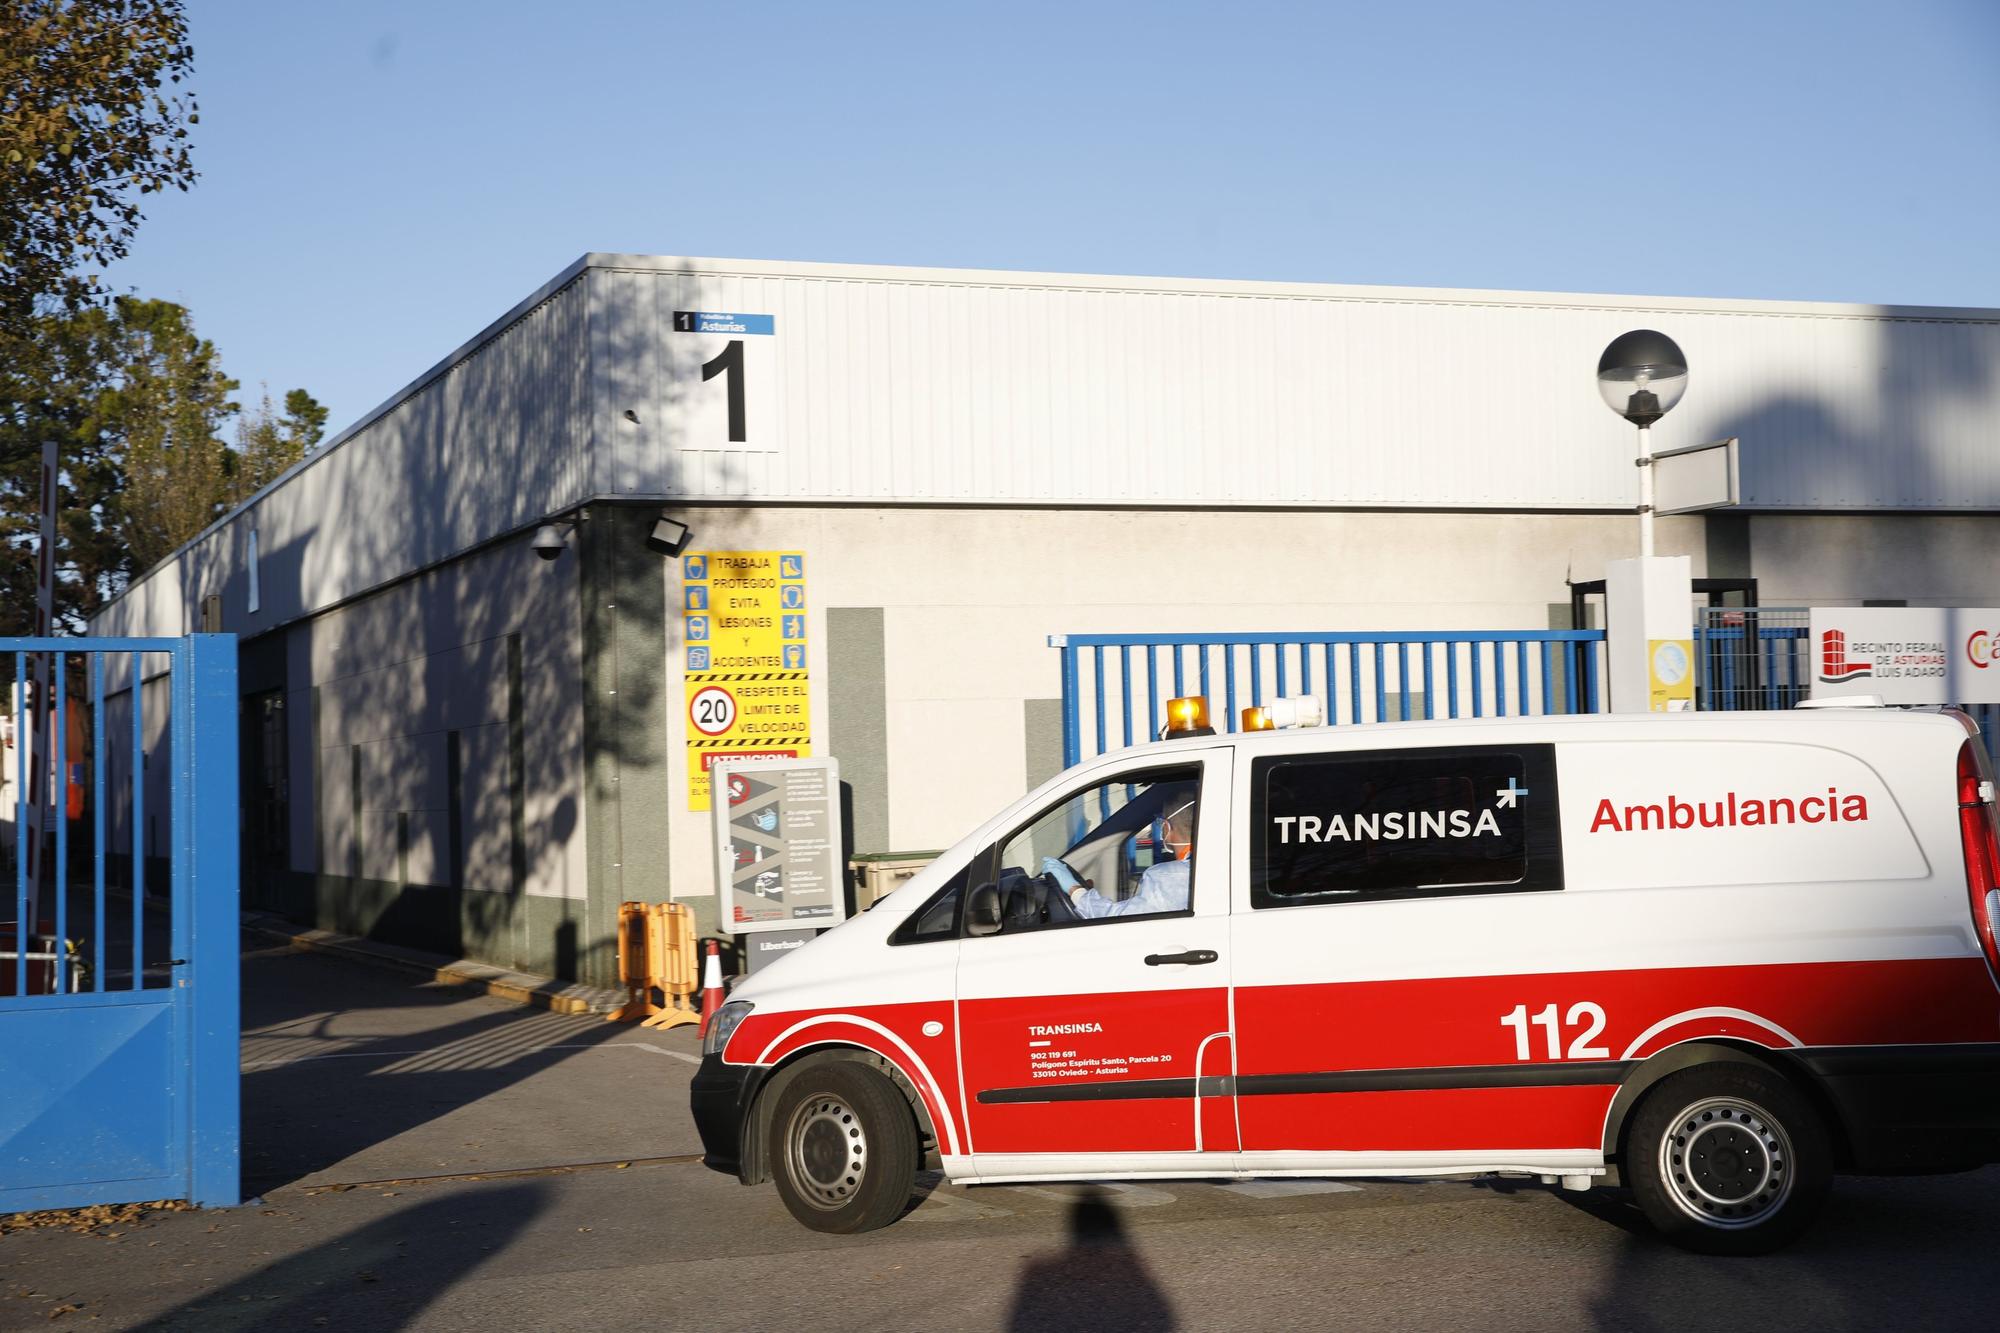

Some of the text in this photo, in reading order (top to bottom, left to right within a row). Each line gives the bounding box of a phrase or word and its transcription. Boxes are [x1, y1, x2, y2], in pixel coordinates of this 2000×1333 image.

[680, 314, 690, 330] 1
[700, 322, 746, 332] Asturias
[702, 340, 746, 442] 1
[718, 558, 770, 569] TRABAJA
[713, 578, 776, 589] PROTEGIDO
[730, 598, 760, 608] EVITA
[719, 617, 772, 628] LESIONES
[743, 637, 750, 647] Y
[1852, 643, 1945, 653] RECINTO FERIAL
[713, 656, 781, 667] ACCIDENTES
[1876, 655, 1946, 665] DE ASTURIAS
[1876, 668, 1946, 678] LUIS ADARO
[736, 686, 807, 697] RESPETE EL
[700, 699, 727, 723] 20
[744, 705, 800, 715] LIMITE DE
[739, 722, 806, 733] VELOCIDAD
[1590, 787, 1868, 833] Ambulancia
[1274, 809, 1502, 843] TRANSINSA
[1029, 1023, 1103, 1036] TRANSINSA
[1500, 1002, 1610, 1061] 112
[1031, 1052, 1047, 1060] 902
[1062, 1050, 1077, 1058] 691
[1101, 1057, 1127, 1065] Santo,
[1129, 1055, 1159, 1063] Parcela
[1033, 1070, 1057, 1078] 33010
[1059, 1069, 1088, 1077] Oviedo
[1096, 1067, 1128, 1075] Asturias
